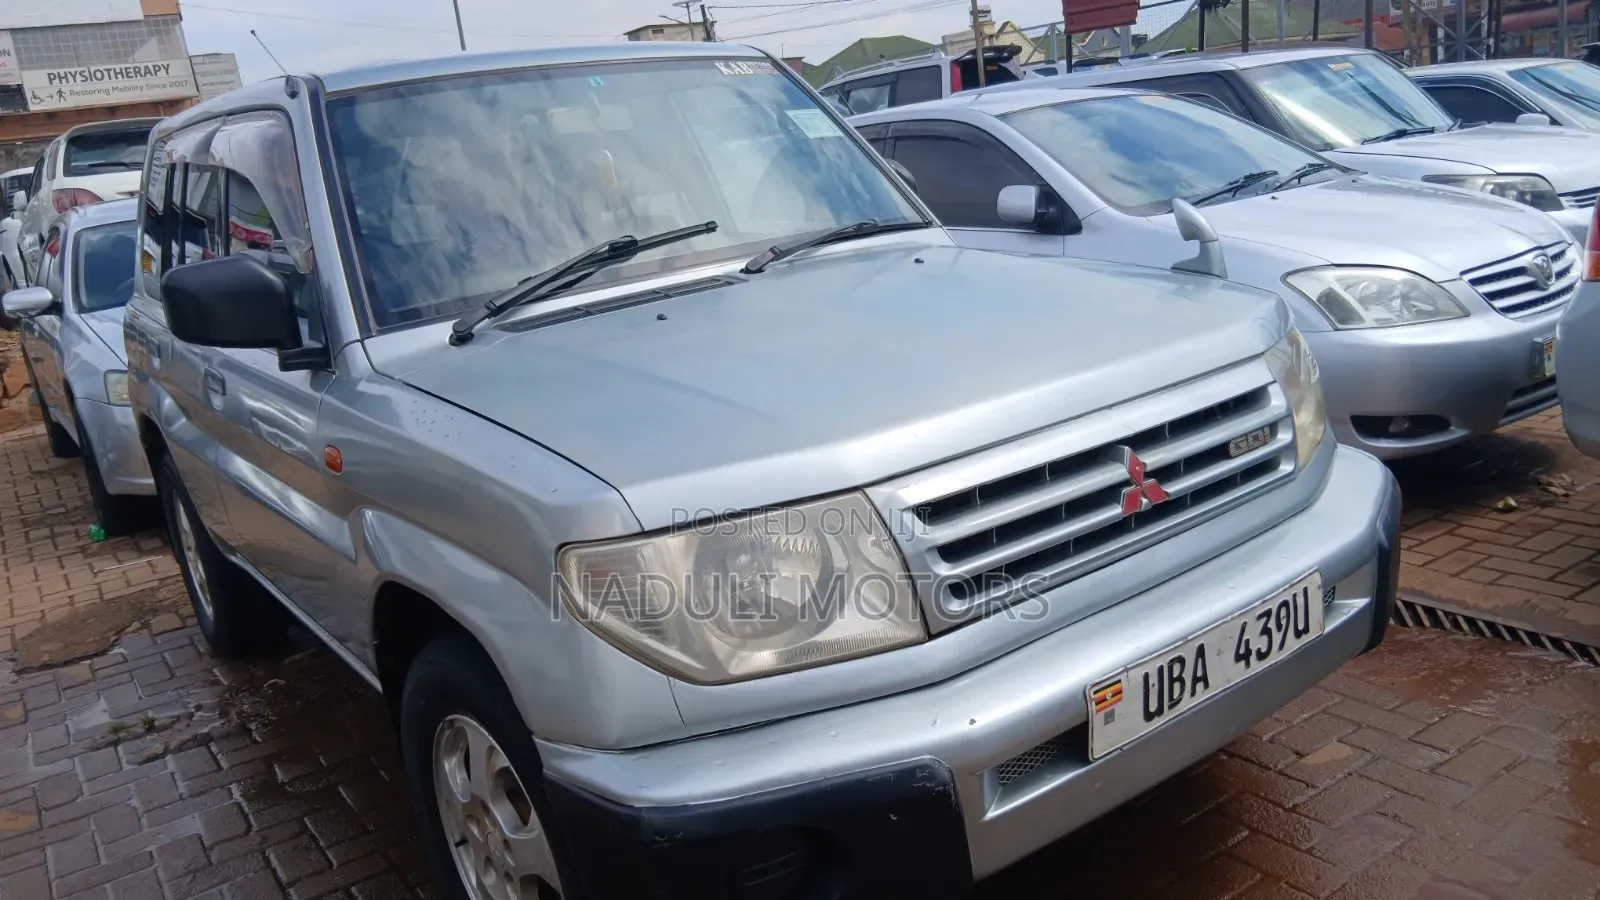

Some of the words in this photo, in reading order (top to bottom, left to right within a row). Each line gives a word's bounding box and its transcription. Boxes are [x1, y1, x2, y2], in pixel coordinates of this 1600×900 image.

[714, 61, 754, 76] KAB
[69, 86, 111, 97] Restoring
[111, 83, 144, 93] Mobility
[145, 81, 167, 91] Since
[1142, 642, 1210, 723] UBA
[1234, 585, 1310, 669] 439U
